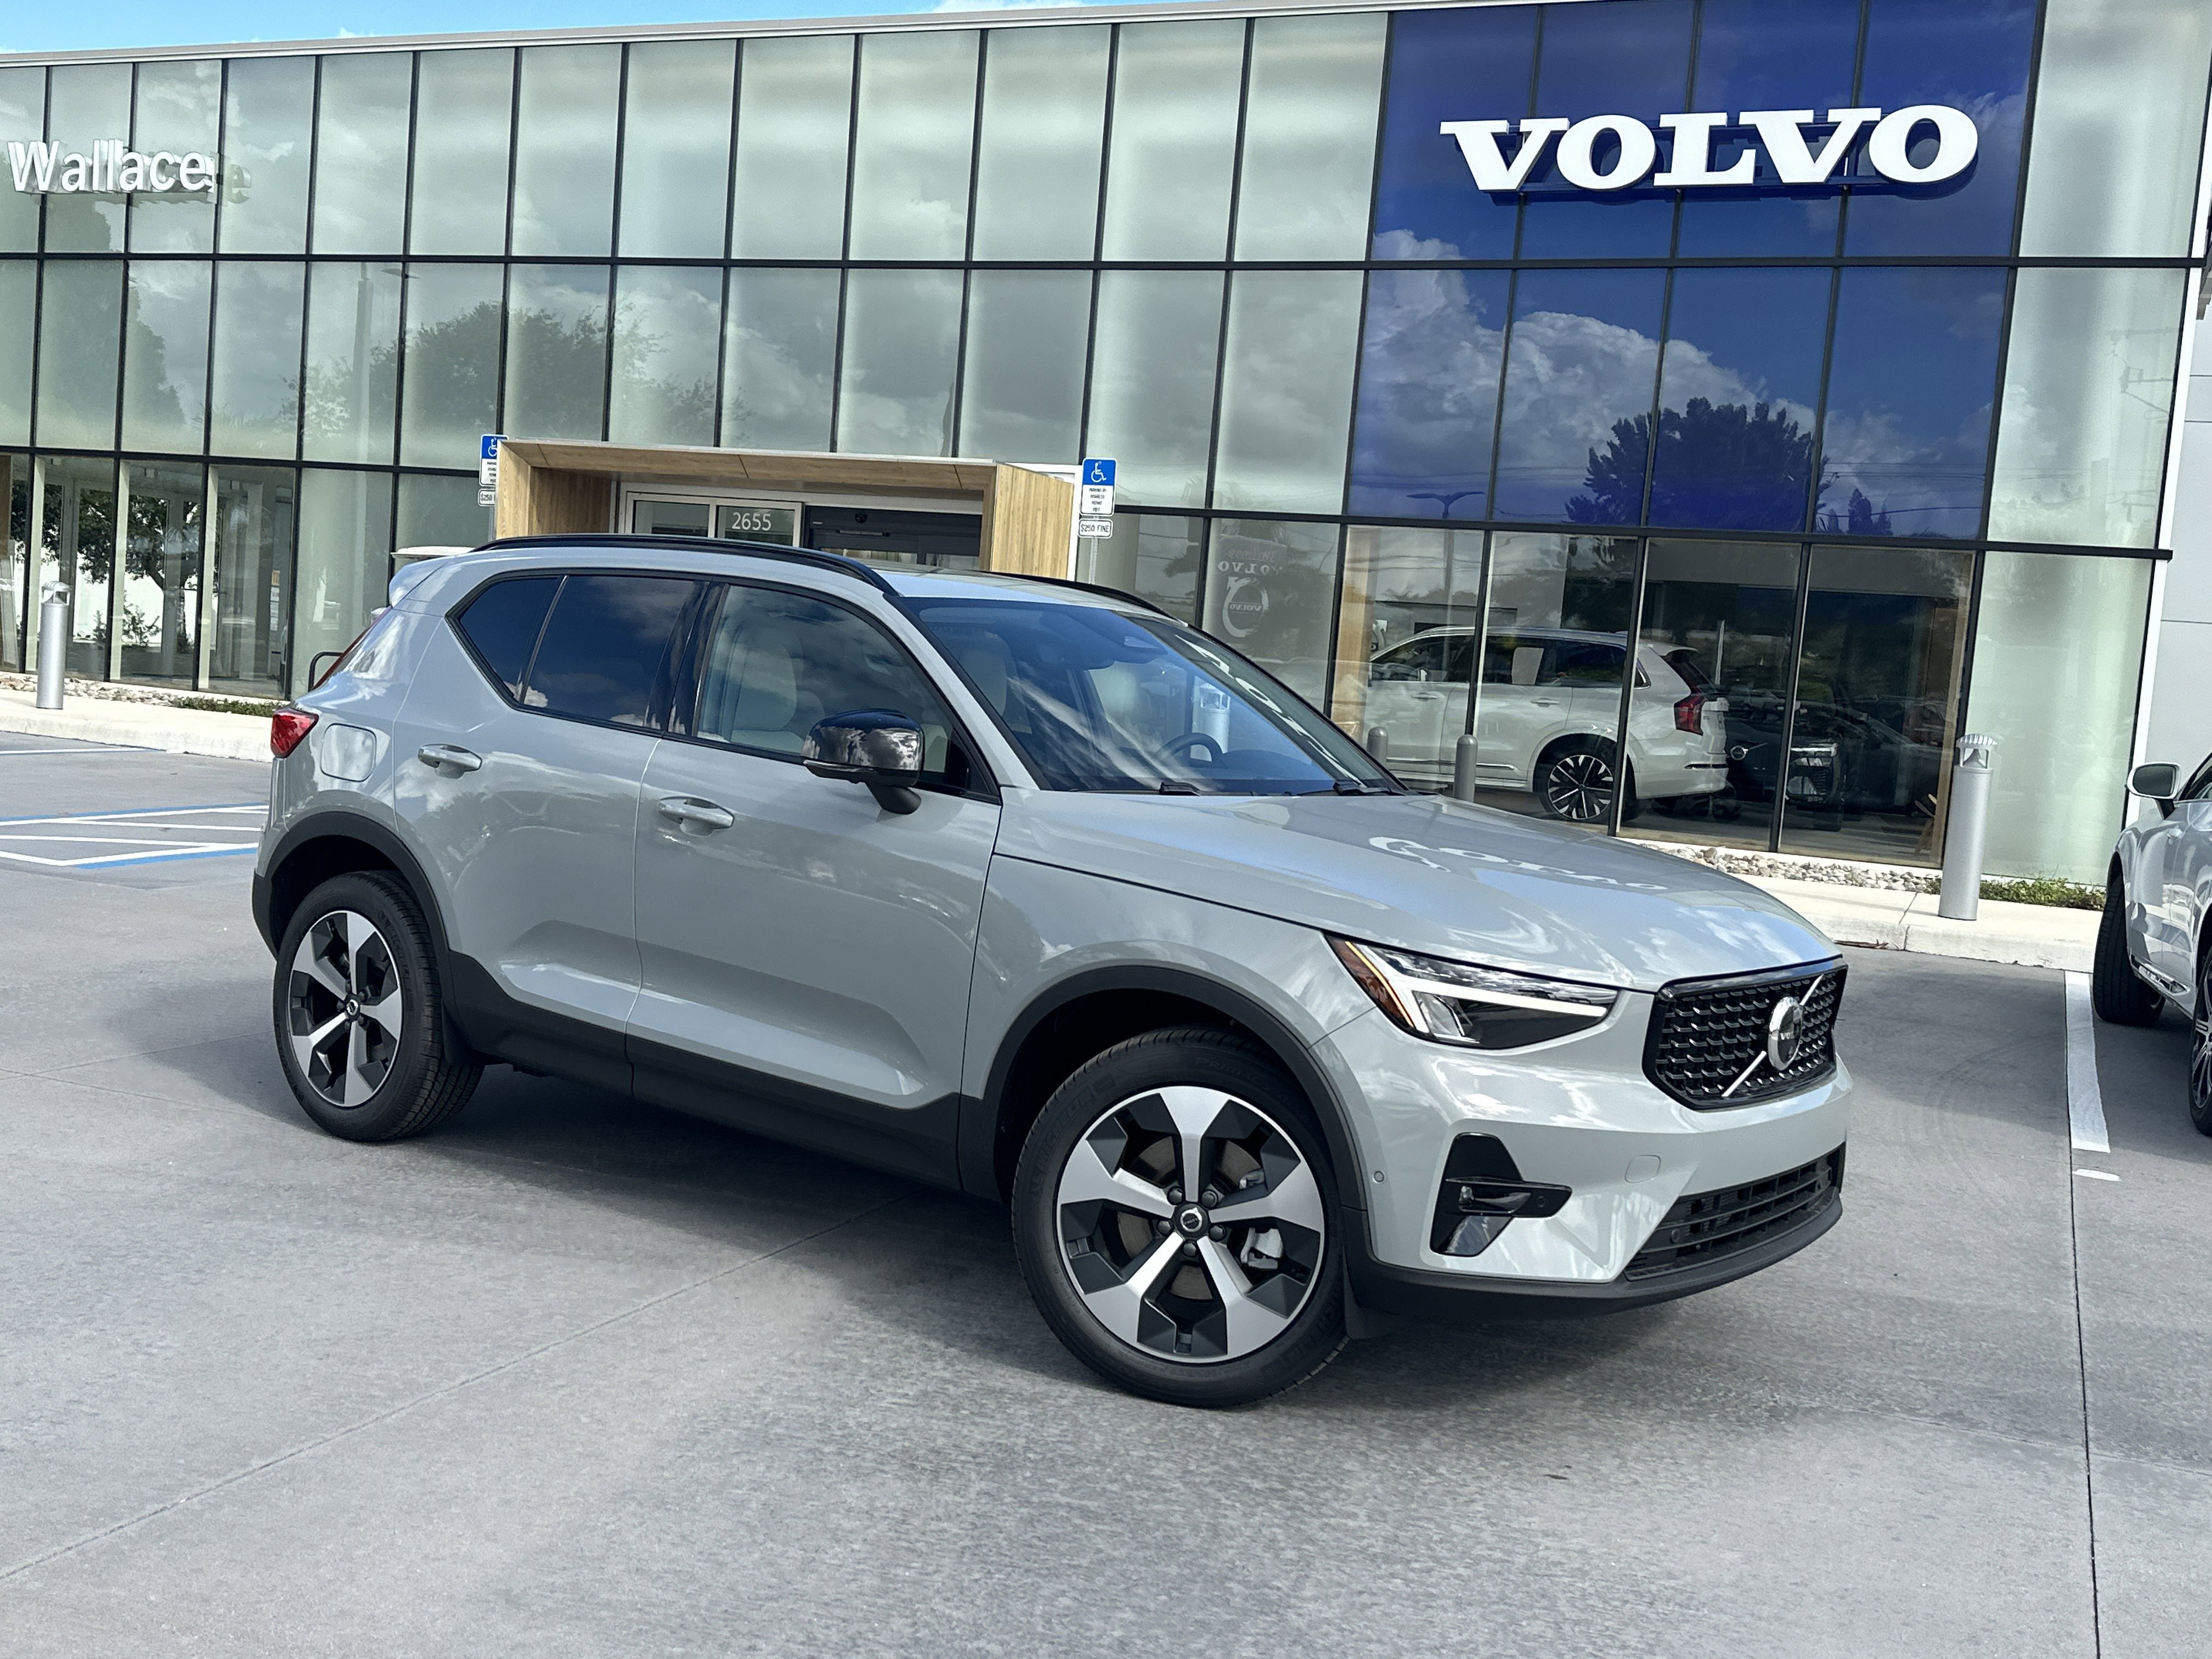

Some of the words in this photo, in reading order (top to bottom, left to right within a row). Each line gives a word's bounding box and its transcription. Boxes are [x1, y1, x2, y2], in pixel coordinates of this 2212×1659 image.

[7, 139, 208, 192] Wallace
[1440, 104, 1978, 191] VOLVO
[732, 512, 771, 531] 2655
[1080, 524, 1095, 533] $250
